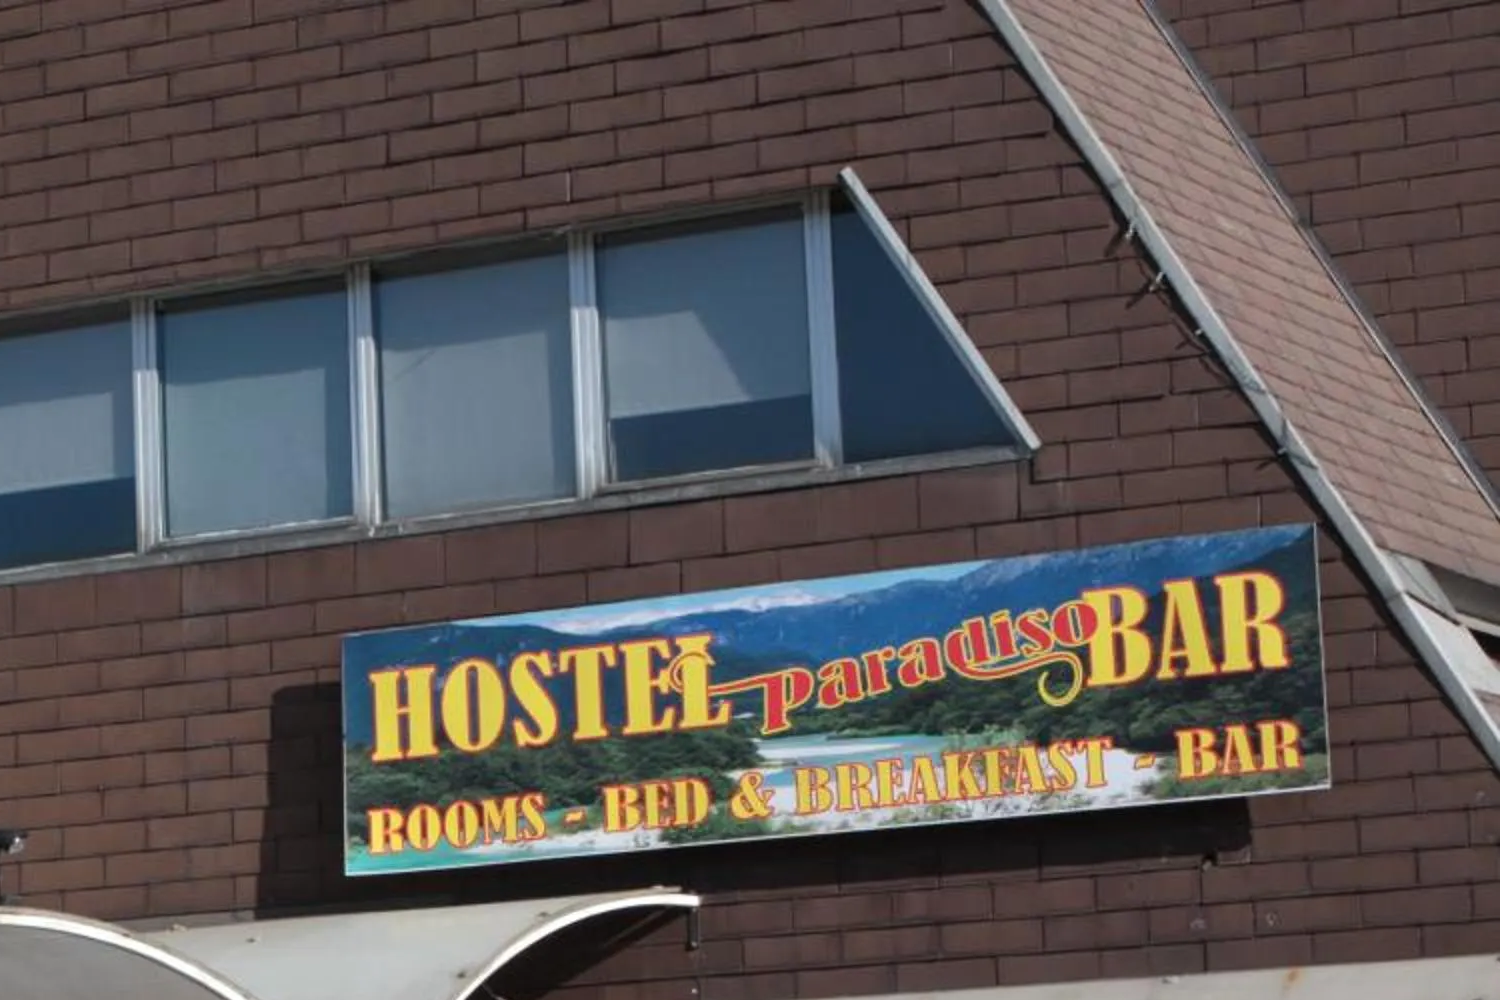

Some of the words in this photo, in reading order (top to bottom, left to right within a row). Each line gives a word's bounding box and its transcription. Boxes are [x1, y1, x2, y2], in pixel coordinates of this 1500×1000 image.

[369, 633, 731, 761] HOSTEL
[1082, 571, 1290, 688] BAR
[367, 792, 546, 854] ROOMS
[565, 809, 585, 825] -
[603, 777, 711, 832] BED
[731, 771, 773, 819] &
[795, 736, 1112, 816] BREAKFAST
[1133, 753, 1156, 770] -
[1174, 719, 1303, 780] BAR
